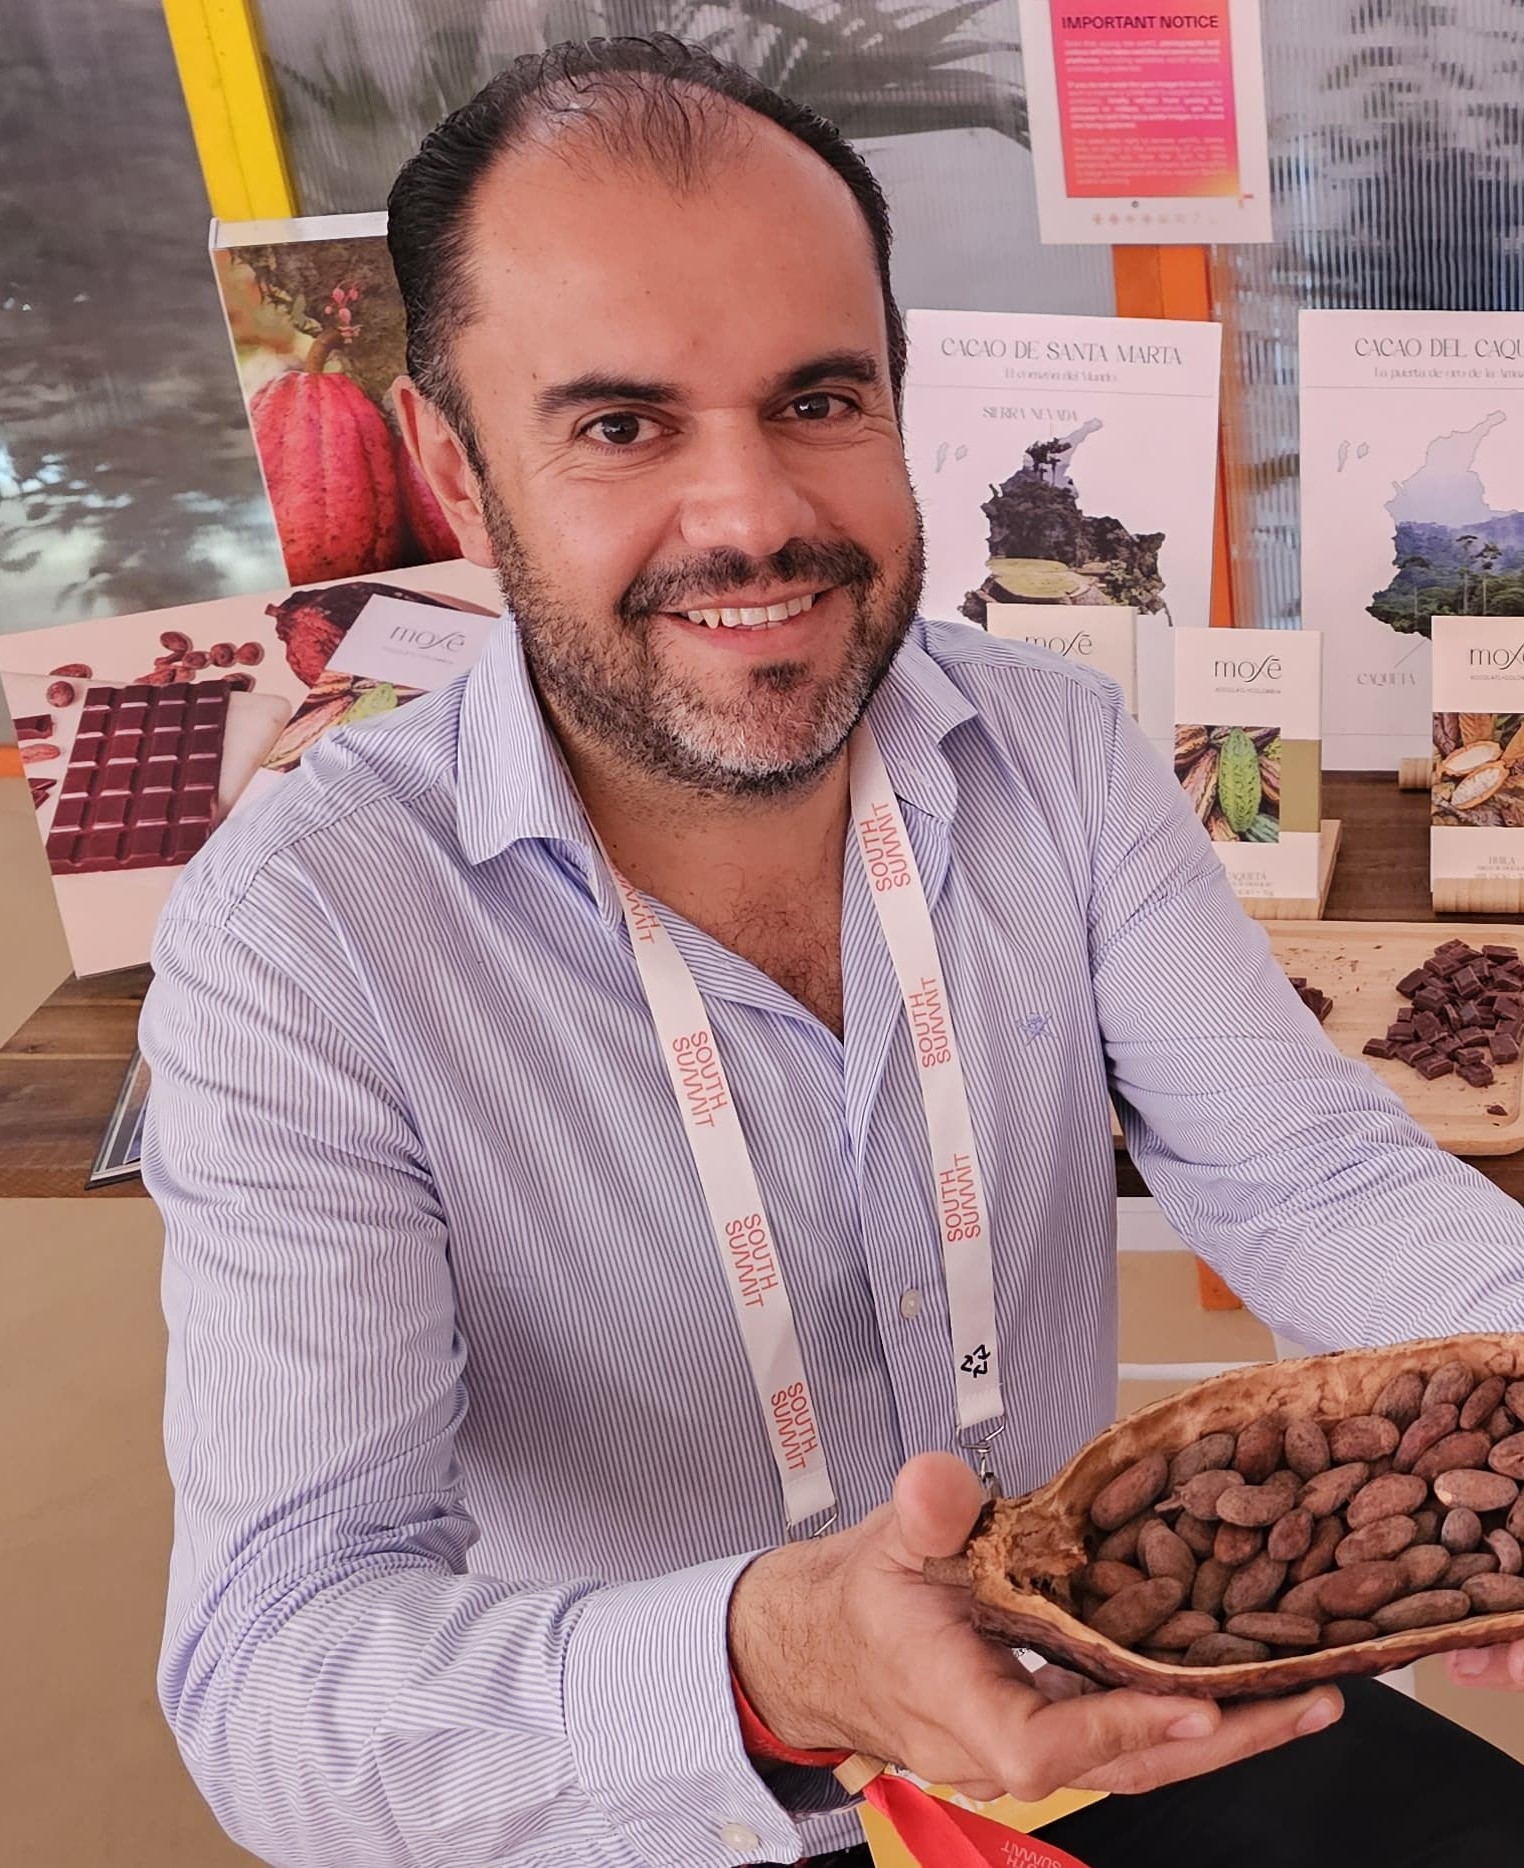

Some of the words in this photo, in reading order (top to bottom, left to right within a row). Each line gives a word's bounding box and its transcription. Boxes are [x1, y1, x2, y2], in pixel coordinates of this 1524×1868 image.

[1062, 16, 1155, 29] IMPORTANT
[1159, 15, 1219, 28] NOTICE
[941, 338, 1007, 358] CACAO
[1015, 340, 1039, 360] DE
[1046, 341, 1108, 362] SANTA
[1116, 344, 1183, 365] MARTA
[1355, 338, 1422, 358] CACAO
[1430, 338, 1467, 358] DEL
[860, 819, 893, 892] SOUTH
[871, 802, 911, 889] SUMMIT
[909, 992, 936, 1068] SOUTH
[920, 976, 951, 1065] SUMMIT
[672, 1036, 715, 1128] SUMMIT
[691, 1030, 727, 1110] SOUTH
[939, 1168, 964, 1243] SOUTH
[953, 1152, 981, 1239] SUMMIT
[725, 1219, 764, 1308] SUMMIT
[743, 1213, 778, 1291] SOUTH
[771, 1390, 807, 1470] SUMMIT
[787, 1382, 818, 1454] SOUTH
